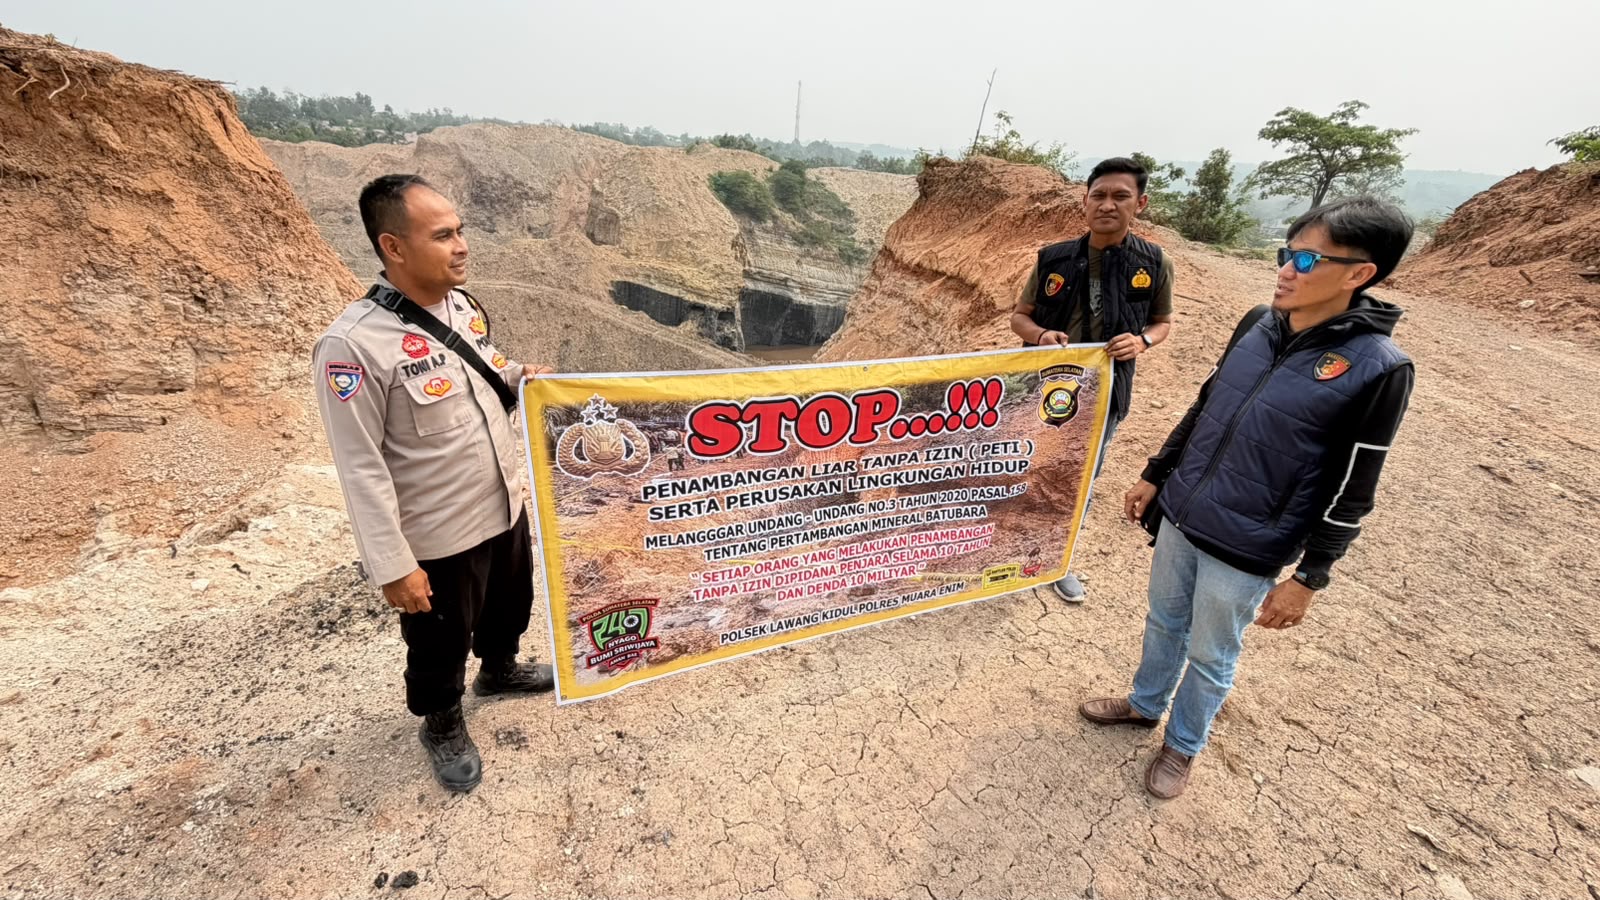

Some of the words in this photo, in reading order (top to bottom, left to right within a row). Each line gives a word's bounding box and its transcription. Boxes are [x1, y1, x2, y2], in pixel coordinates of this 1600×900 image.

[401, 358, 431, 378] TONI
[431, 353, 446, 369] A.P
[687, 377, 1003, 457] STOP...!!!
[642, 466, 805, 500] PENAMBANGAN
[811, 460, 856, 477] LIAR
[863, 451, 918, 470] TANPA
[925, 446, 964, 462] IZIN
[649, 501, 720, 521] SERTA
[726, 480, 842, 510] PERUSAKAN
[848, 465, 966, 491] LINGKUNGAN
[971, 460, 1029, 477] HIDUP
[646, 524, 744, 549] MELANGGGAR
[748, 513, 802, 535] UNDANG
[814, 506, 865, 522] UNDANG
[868, 501, 896, 513] NO.3
[900, 495, 937, 509] TAHUN
[939, 489, 968, 502] 2020
[971, 487, 1007, 500] PASAL
[1010, 482, 1026, 496] 158
[704, 539, 767, 561] TENTANG
[770, 521, 869, 549] PERTAMBANGAN
[872, 516, 923, 531] MINERAL
[926, 506, 987, 522] BATUBARA
[693, 584, 739, 602] TANPA
[742, 577, 771, 593] IZIN
[775, 565, 836, 587] DIPIDANA
[840, 556, 890, 573] PENJARA
[893, 549, 938, 564] SELAMA
[940, 546, 954, 558] 10
[957, 538, 991, 554] TAHUN
[703, 566, 751, 583] SETIAP
[754, 557, 799, 575] ORANG
[802, 550, 835, 565] YANG
[839, 537, 907, 560] MELAKUKAN
[911, 525, 994, 545] PENAMBANGAN
[777, 588, 804, 602] DAN
[807, 578, 847, 596] DENDA
[851, 575, 864, 587] 10
[867, 565, 916, 583] MILIYAR
[582, 611, 602, 622] POLDA
[602, 601, 631, 613] SUMATERA
[720, 627, 768, 644] POLSEK
[770, 613, 819, 633] LAWANG
[822, 604, 856, 620] KIDUL
[859, 598, 899, 614] POLRES
[901, 589, 937, 605] MUARA
[939, 582, 965, 596] ENIM
[590, 651, 613, 665] BUMI
[614, 640, 656, 654] SRIWIJAYA
[608, 635, 637, 648] NYAGO
